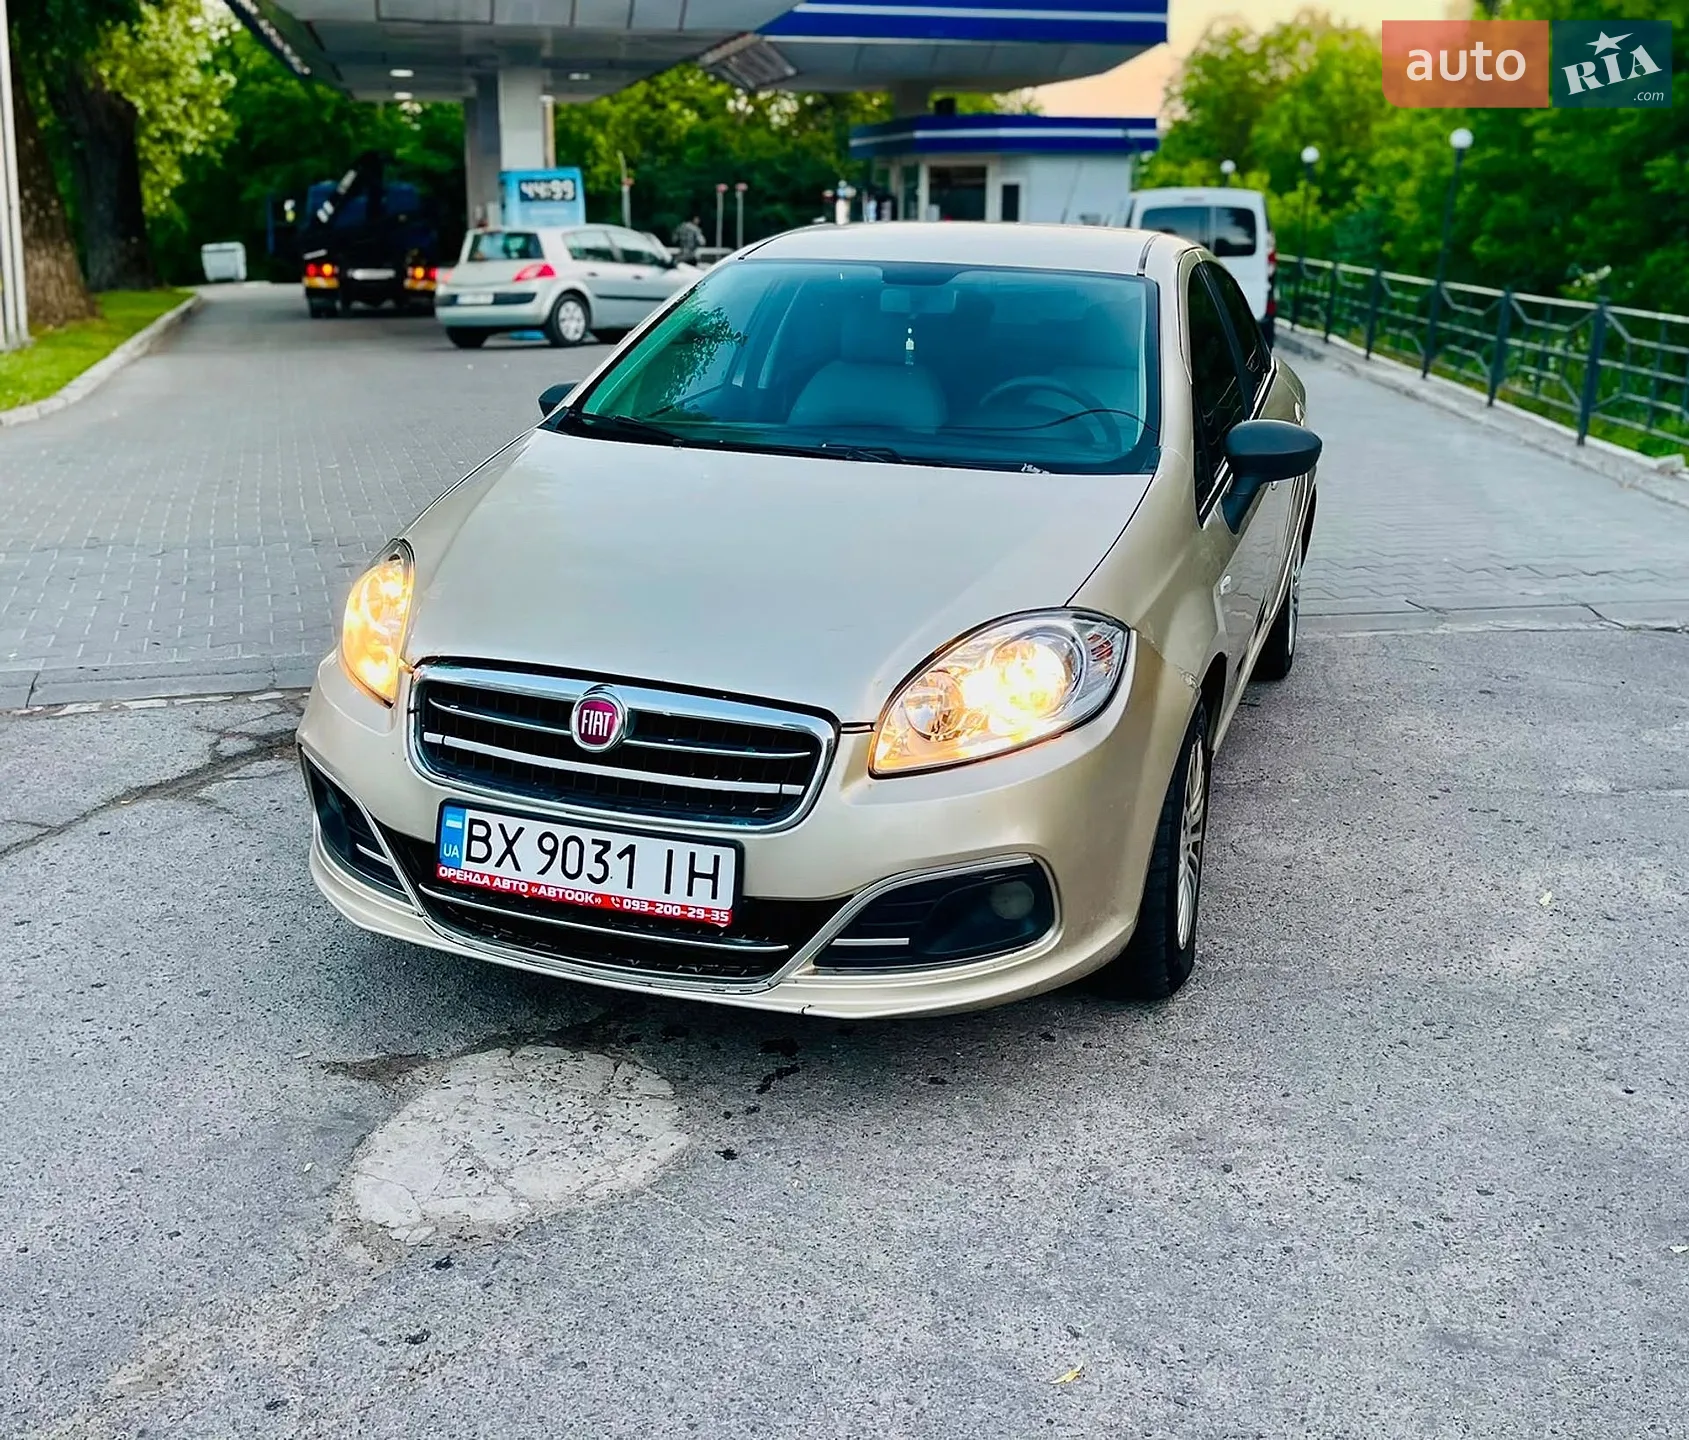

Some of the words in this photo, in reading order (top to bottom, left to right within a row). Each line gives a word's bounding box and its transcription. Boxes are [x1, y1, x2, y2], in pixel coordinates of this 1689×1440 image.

[581, 709, 613, 737] FIAT
[443, 842, 460, 858] UA
[465, 818, 526, 872] BX
[536, 831, 637, 889] 9031
[664, 849, 721, 900] IH
[438, 865, 491, 886] ОРЕНДА
[493, 876, 529, 893] АВТО
[622, 899, 730, 922] 093-200-29-35
